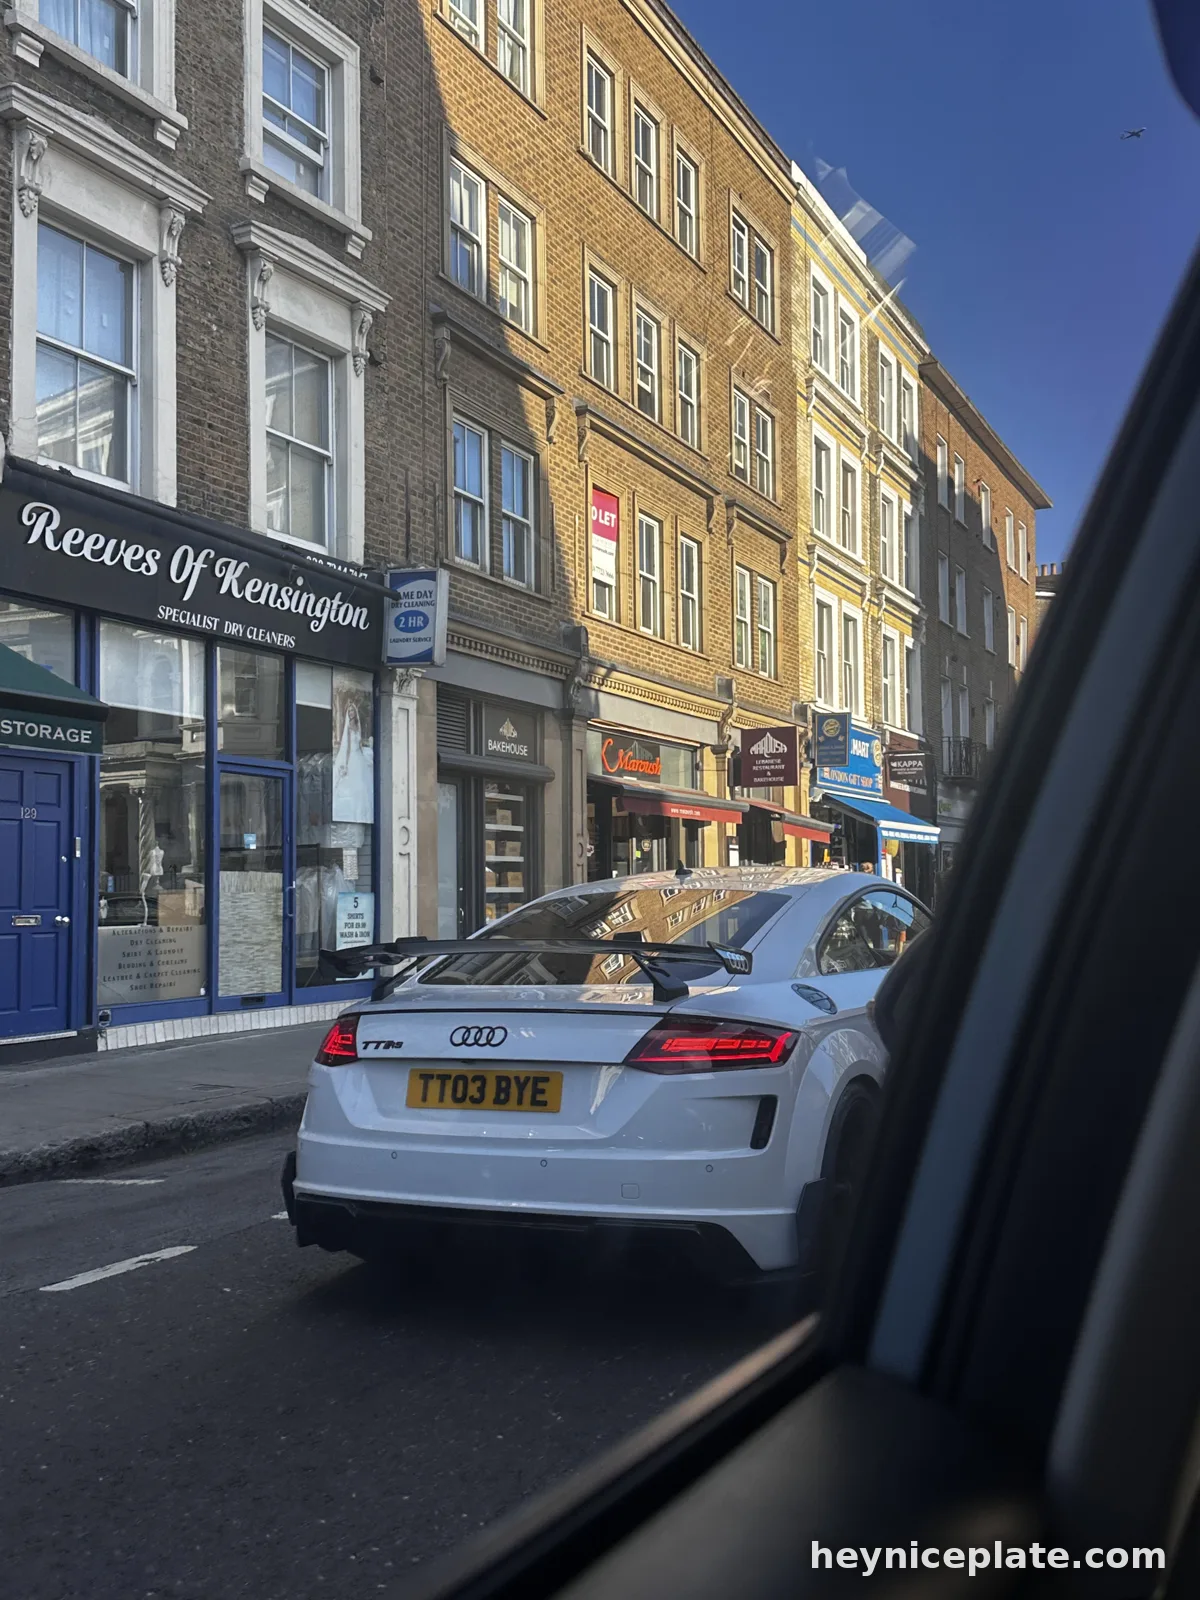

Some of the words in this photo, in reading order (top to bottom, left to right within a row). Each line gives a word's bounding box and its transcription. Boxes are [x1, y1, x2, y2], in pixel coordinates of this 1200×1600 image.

[592, 506, 597, 520] O
[599, 509, 616, 527] LET
[22, 502, 161, 575] Reeves
[170, 545, 215, 601] Of
[214, 557, 369, 632] Kensington
[400, 591, 414, 600] AME
[417, 591, 433, 599] DAY
[157, 605, 219, 631] SPECIALIST
[224, 620, 245, 637] DRY
[246, 626, 295, 648] CLEANERS
[399, 617, 405, 627] 2
[408, 616, 424, 627] HR
[0, 720, 92, 743] STORAGE
[488, 740, 528, 756] BAKEHOUSE
[20, 807, 36, 819] 129
[353, 897, 359, 908] 5
[418, 1073, 487, 1104] TT03
[492, 1075, 550, 1107] BYE
